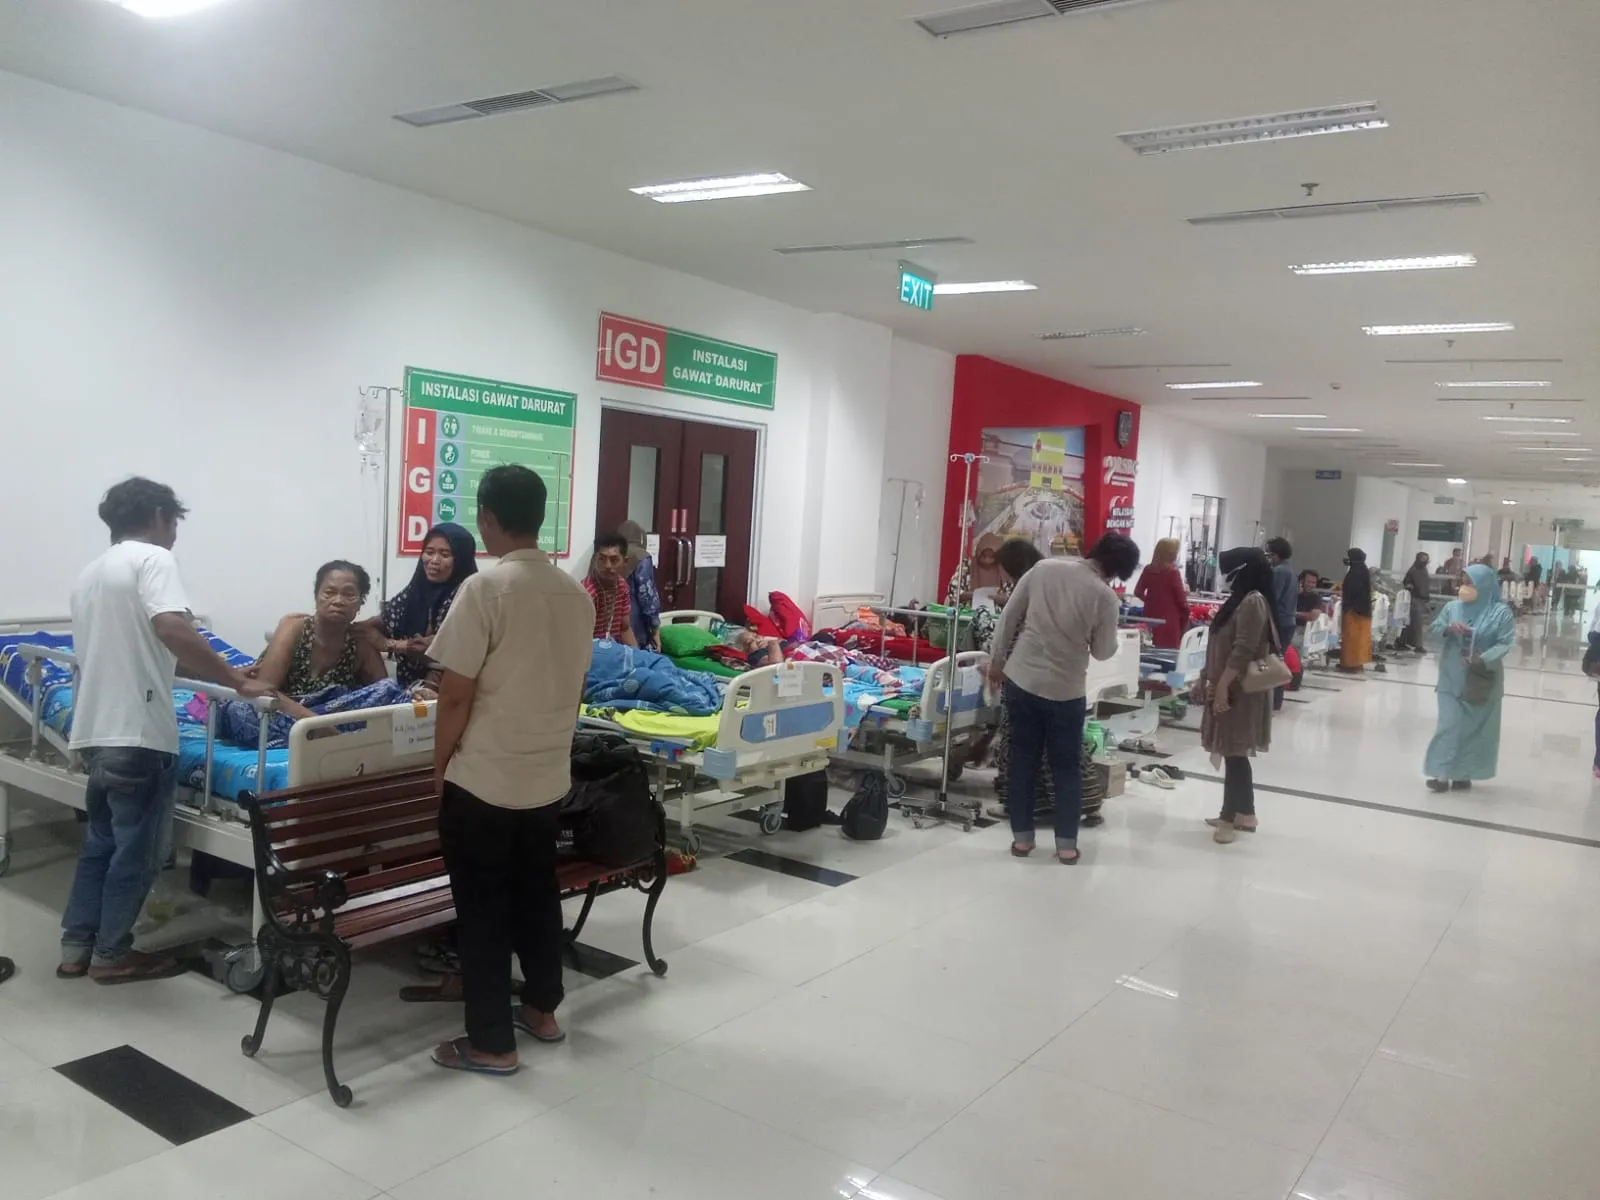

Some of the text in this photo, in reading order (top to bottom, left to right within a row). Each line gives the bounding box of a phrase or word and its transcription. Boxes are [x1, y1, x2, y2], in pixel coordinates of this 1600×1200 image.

[901, 274, 933, 310] EXIT
[604, 328, 661, 374] IGD
[692, 349, 748, 372] INSTALASI
[672, 366, 763, 394] GAWAT DARURAT
[421, 381, 566, 415] INSTALASI GAWAT DARURAT
